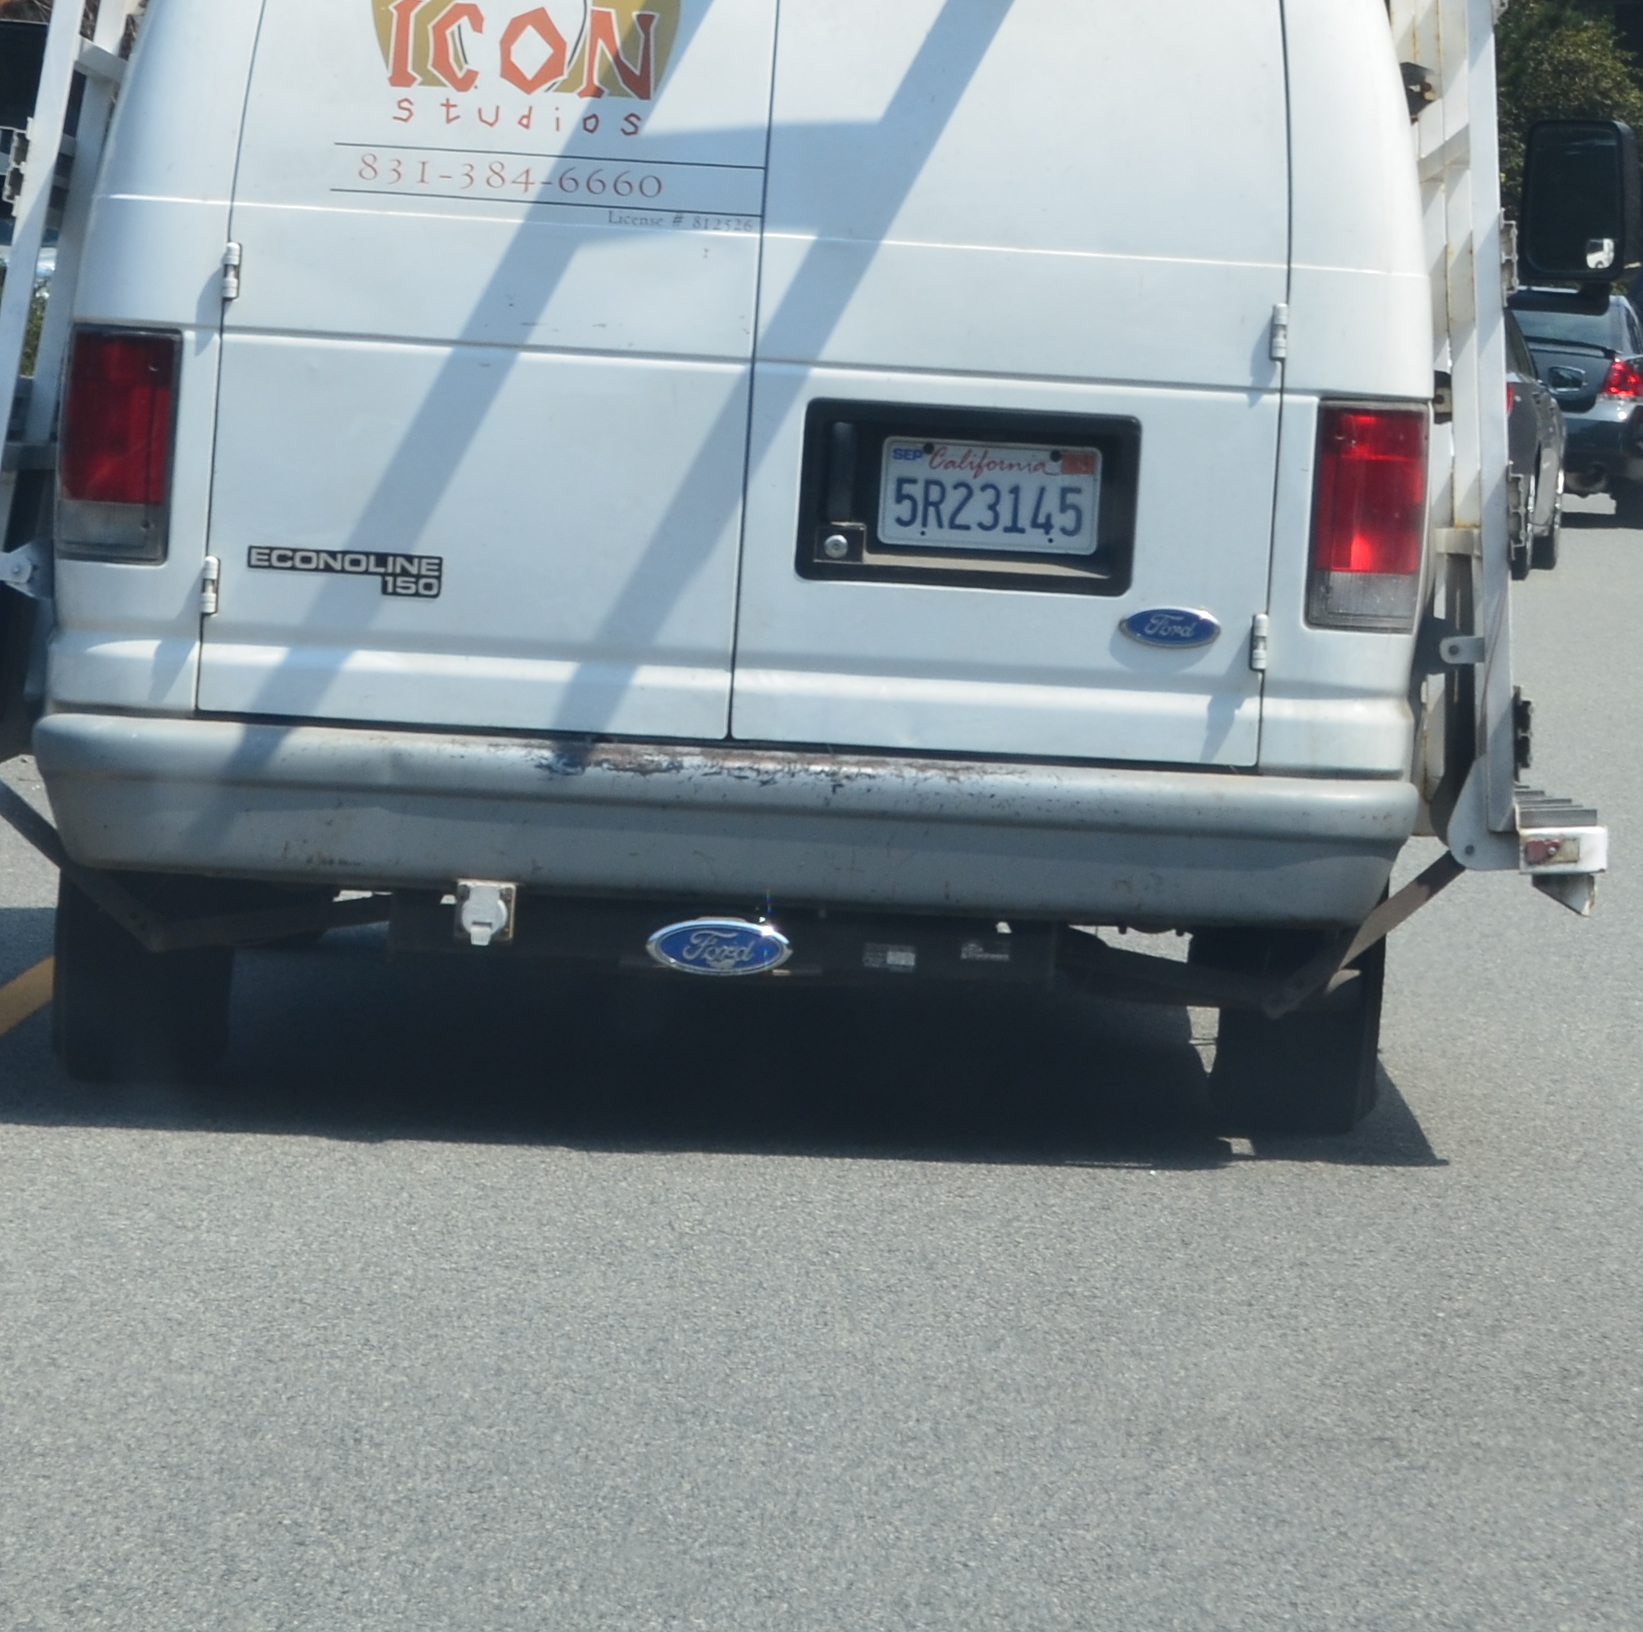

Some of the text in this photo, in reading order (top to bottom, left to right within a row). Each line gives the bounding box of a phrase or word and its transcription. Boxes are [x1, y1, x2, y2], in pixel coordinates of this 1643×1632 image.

[358, 153, 663, 199] 831-384-6660
[608, 210, 753, 232] License # 812526
[892, 448, 922, 461] SEP
[928, 446, 1060, 479] California
[894, 477, 1083, 537] 5R23145
[250, 548, 442, 577] ECONOLINE
[384, 575, 439, 596] 150
[1144, 614, 1197, 638] Ford
[682, 930, 755, 964] Ford
